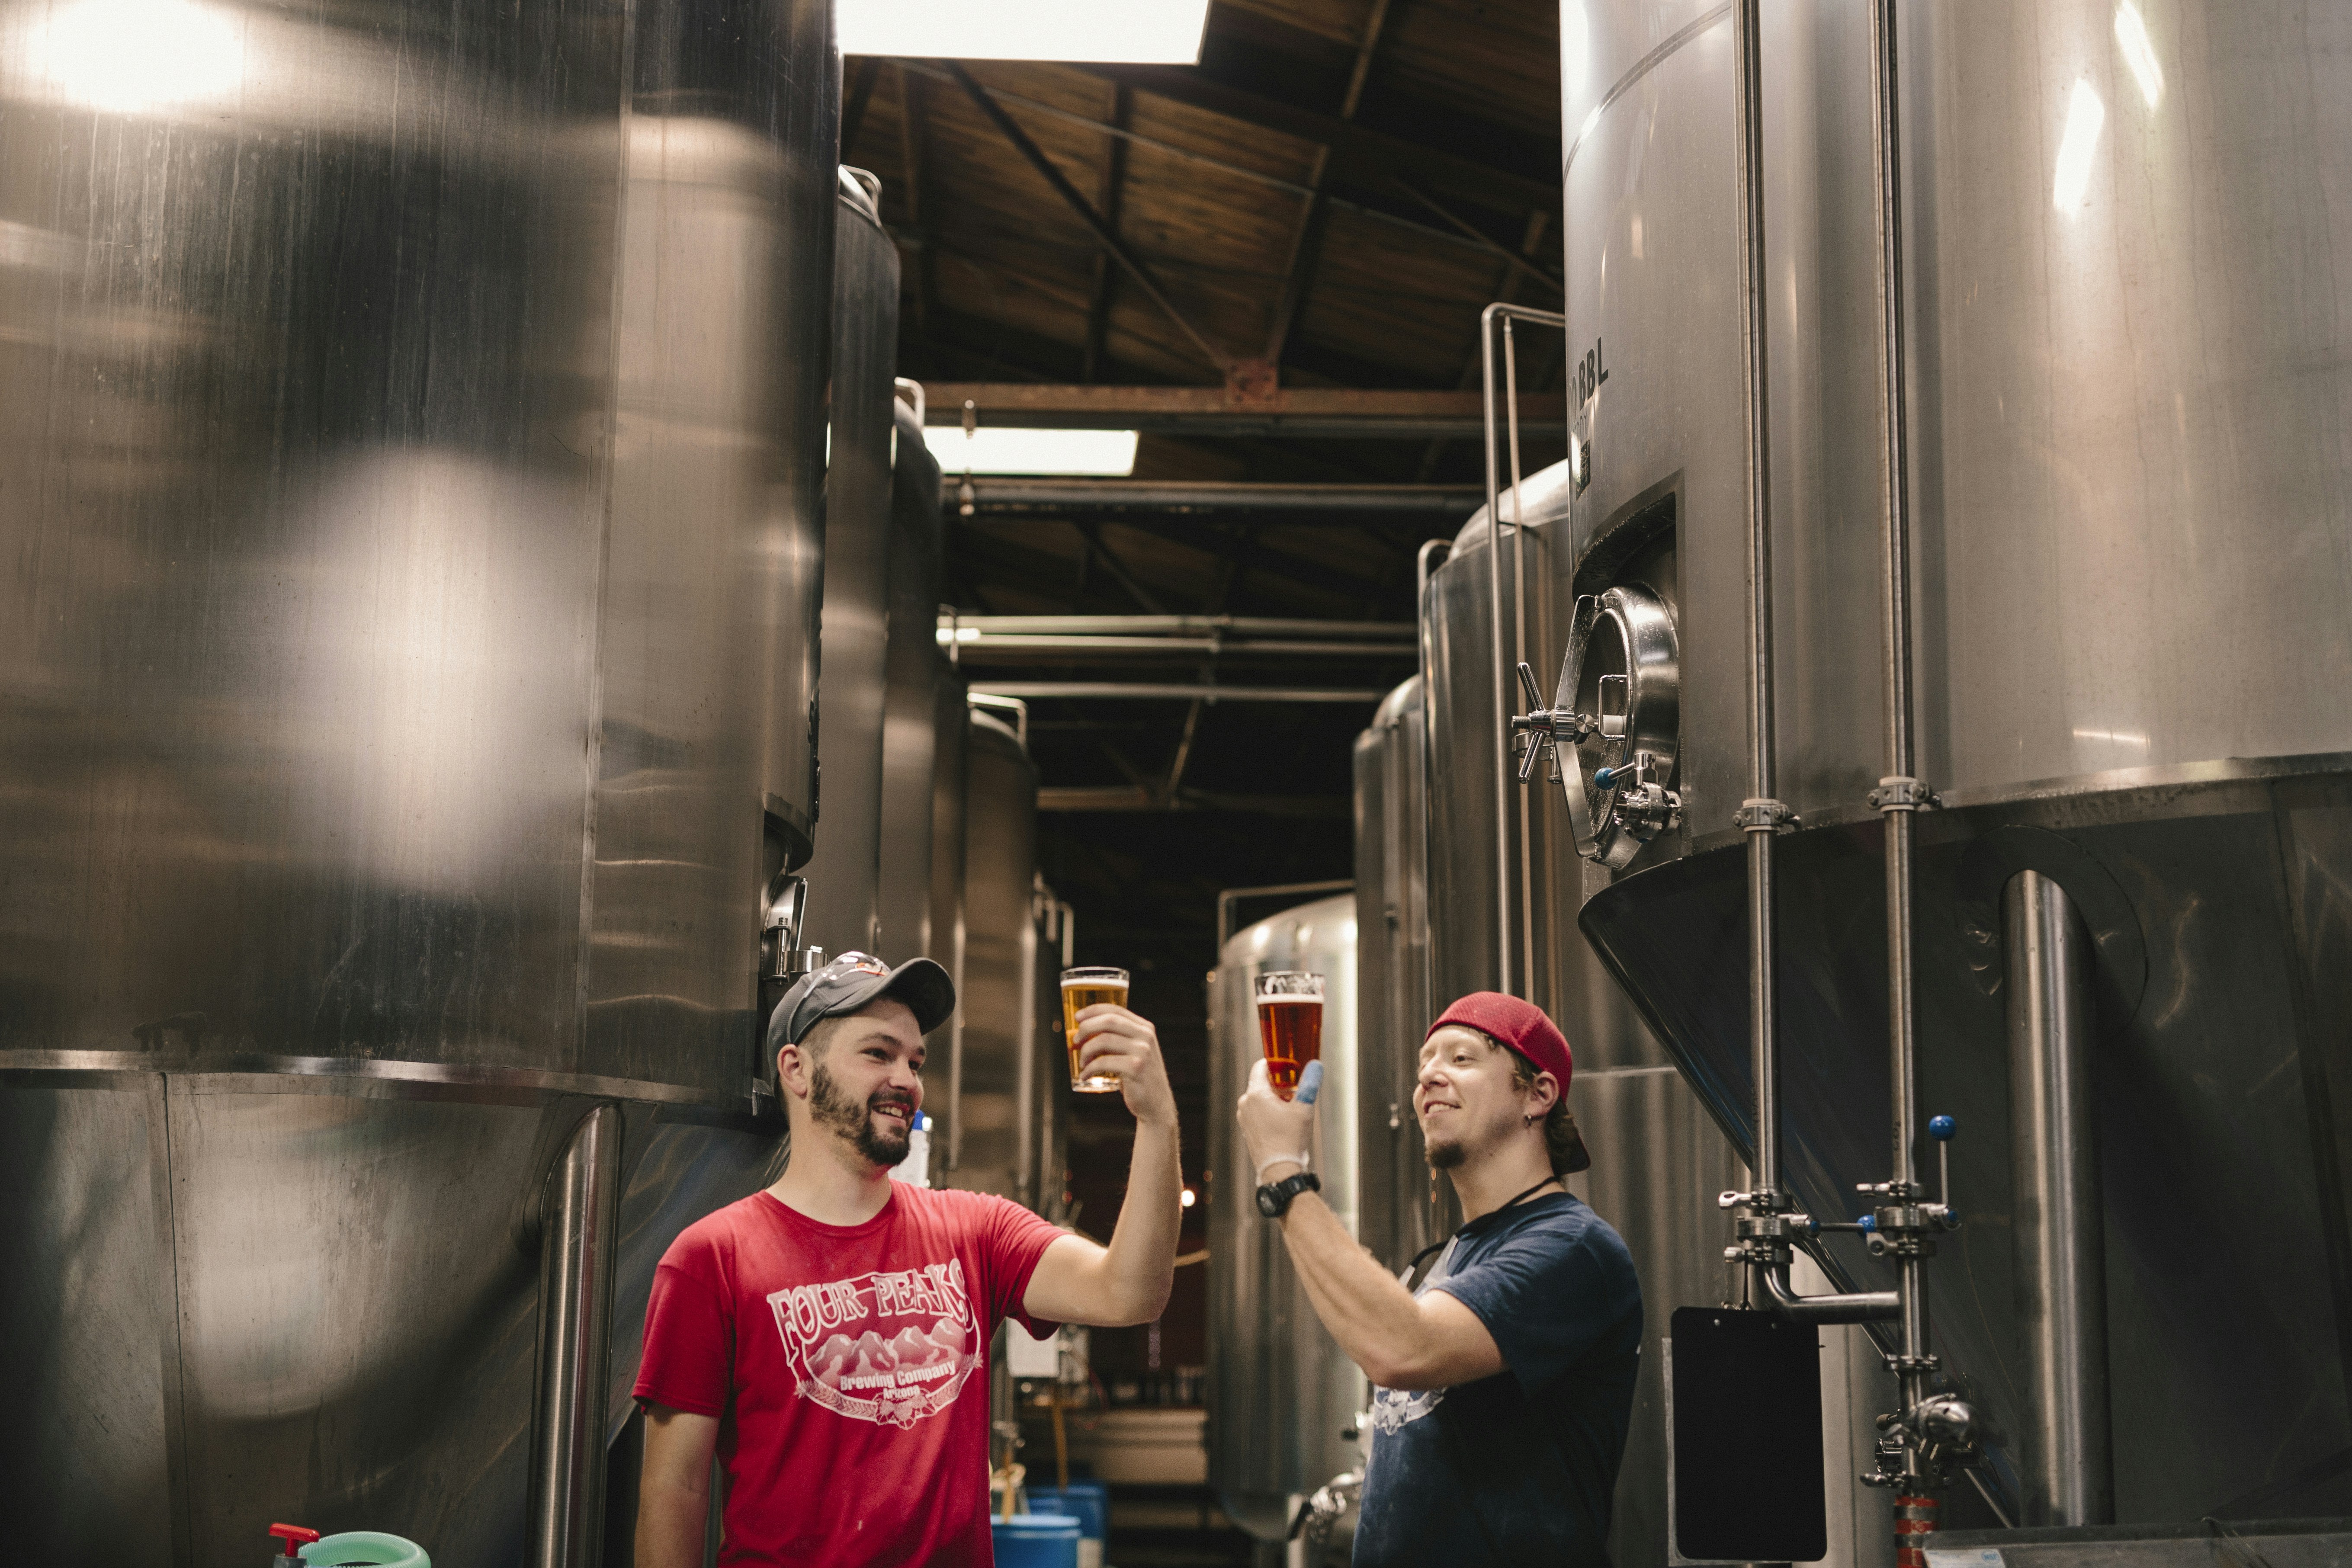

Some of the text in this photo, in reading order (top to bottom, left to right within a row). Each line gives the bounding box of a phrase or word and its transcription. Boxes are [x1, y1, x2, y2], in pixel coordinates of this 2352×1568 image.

[1579, 337, 1608, 411] BBL
[767, 1258, 975, 1367] FOUR PEAKS
[840, 1360, 956, 1391] Brewing Company
[883, 1384, 921, 1400] Arizona
